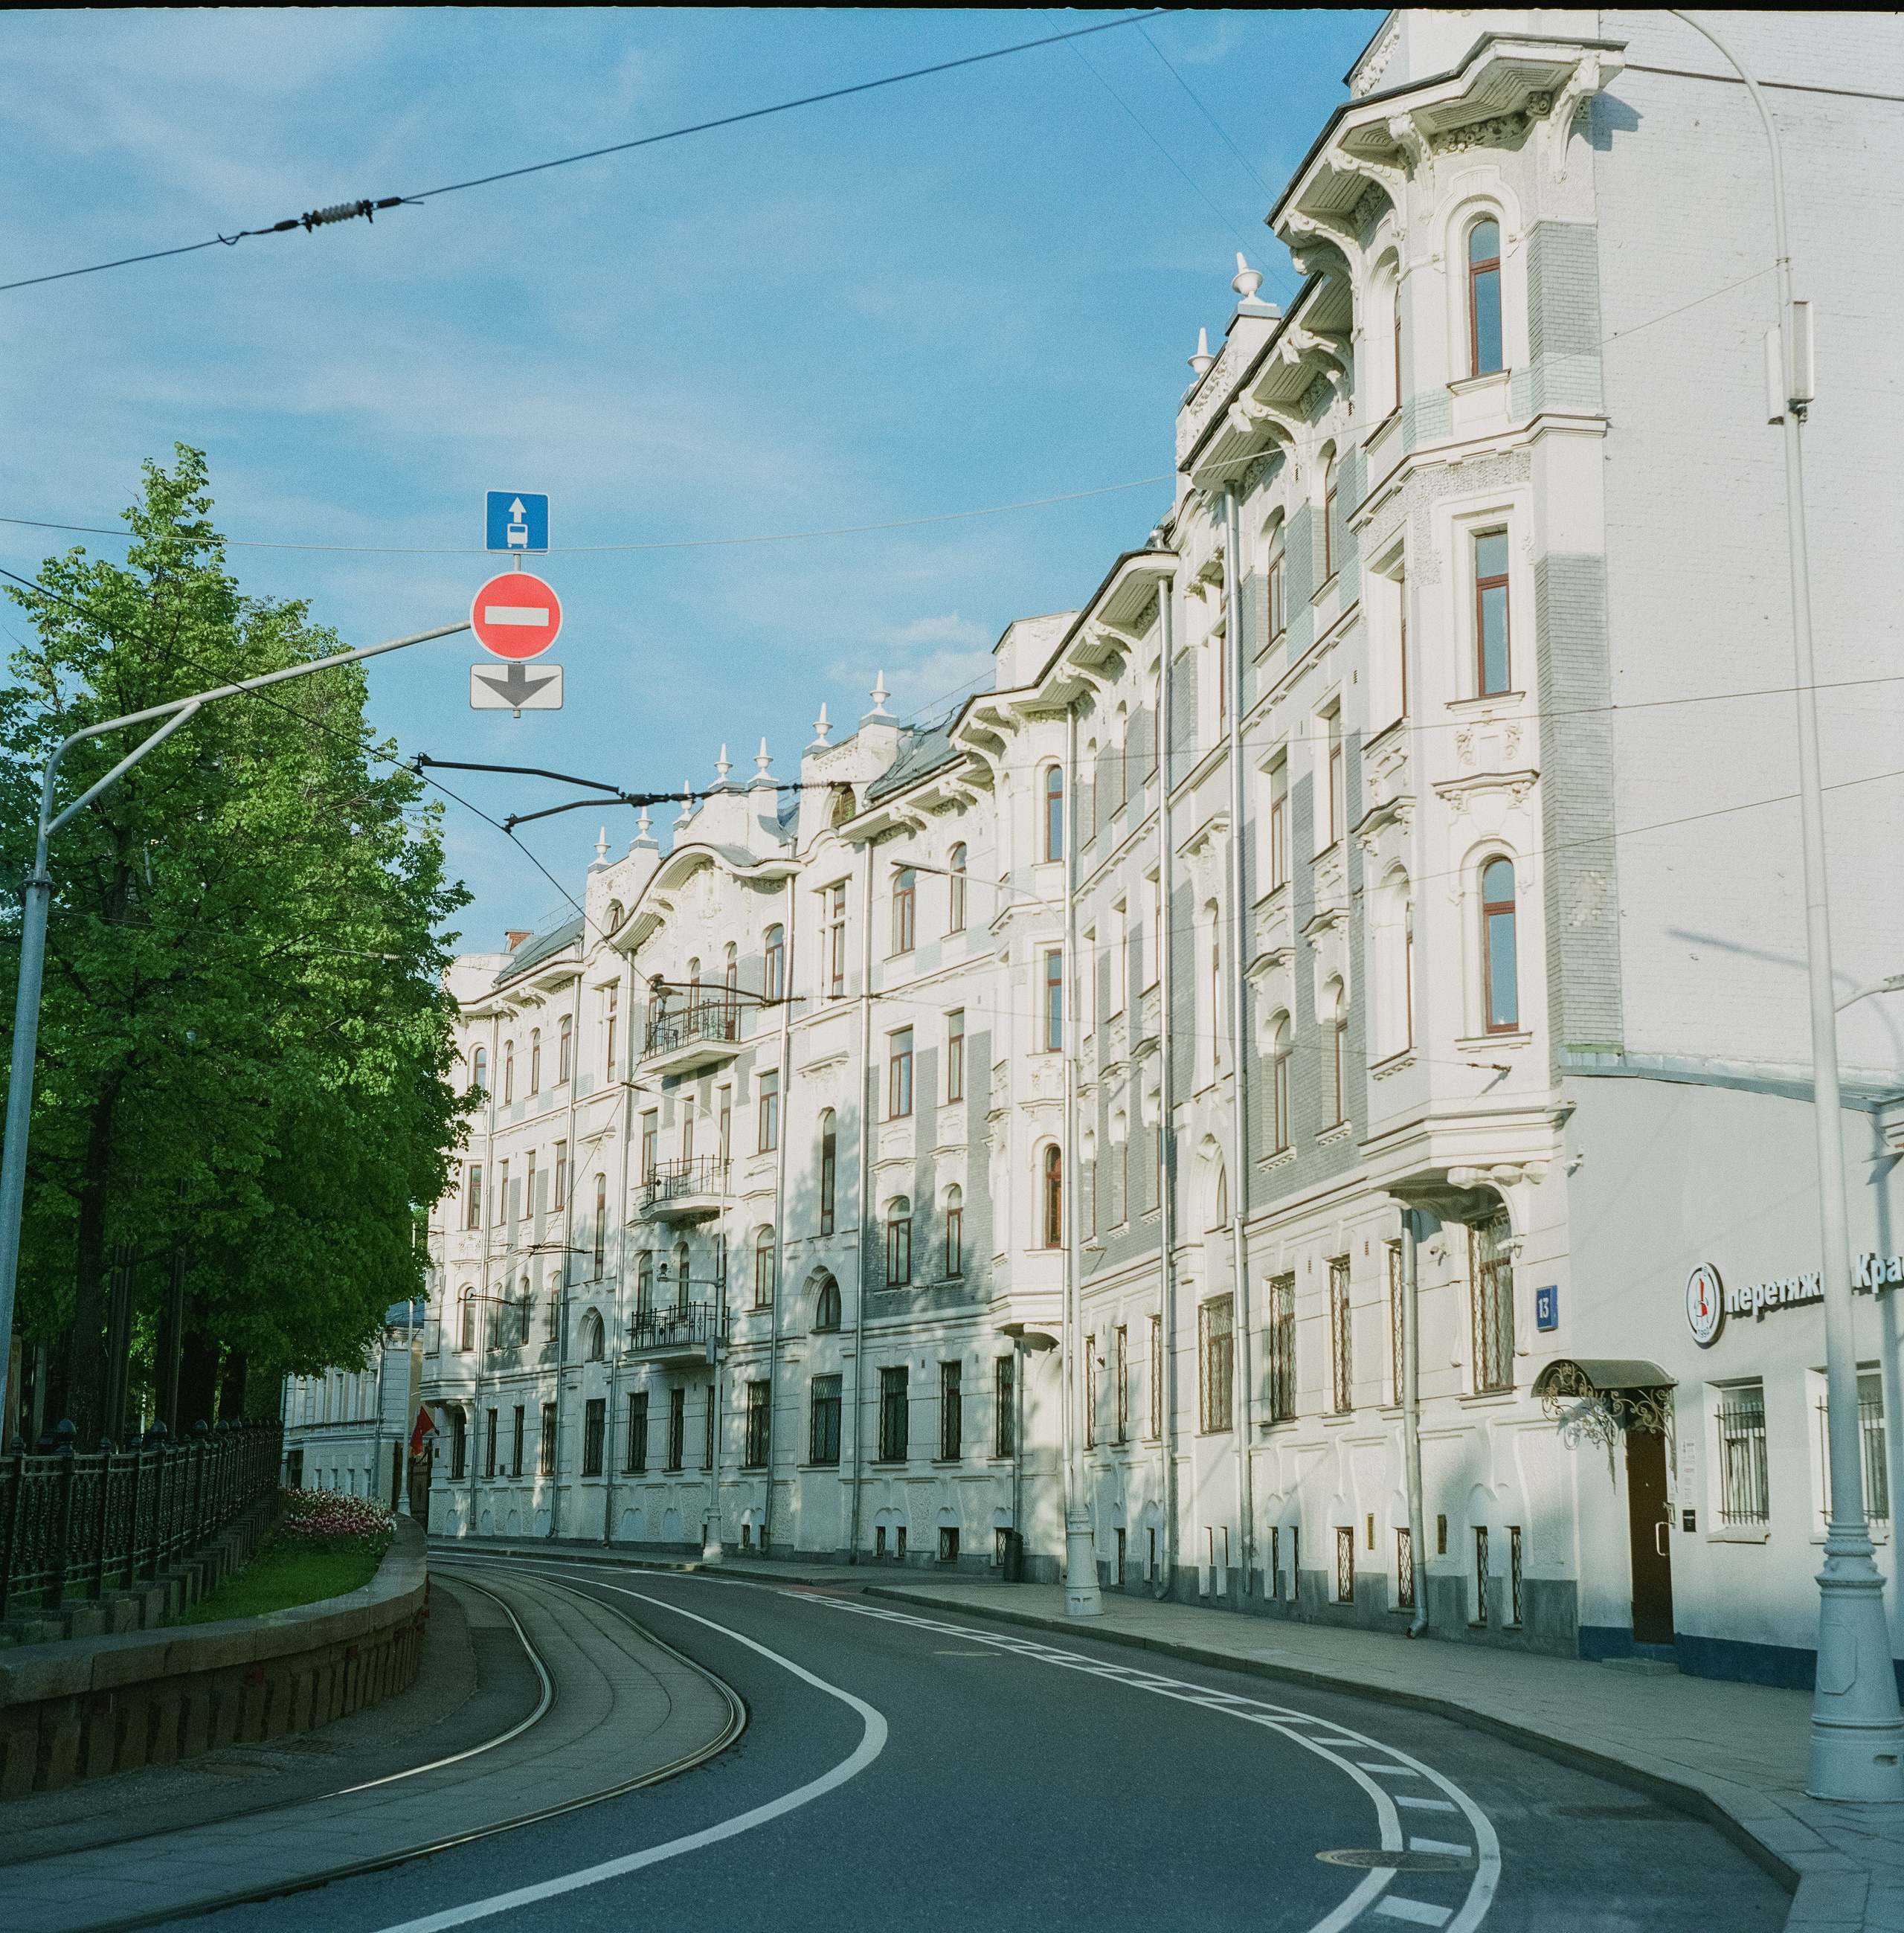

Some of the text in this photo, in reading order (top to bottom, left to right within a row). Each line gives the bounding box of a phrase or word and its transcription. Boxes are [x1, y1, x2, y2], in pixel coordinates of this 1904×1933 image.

[1726, 1252, 1904, 1316] перетяж Кра
[1538, 1297, 1549, 1319] 13
